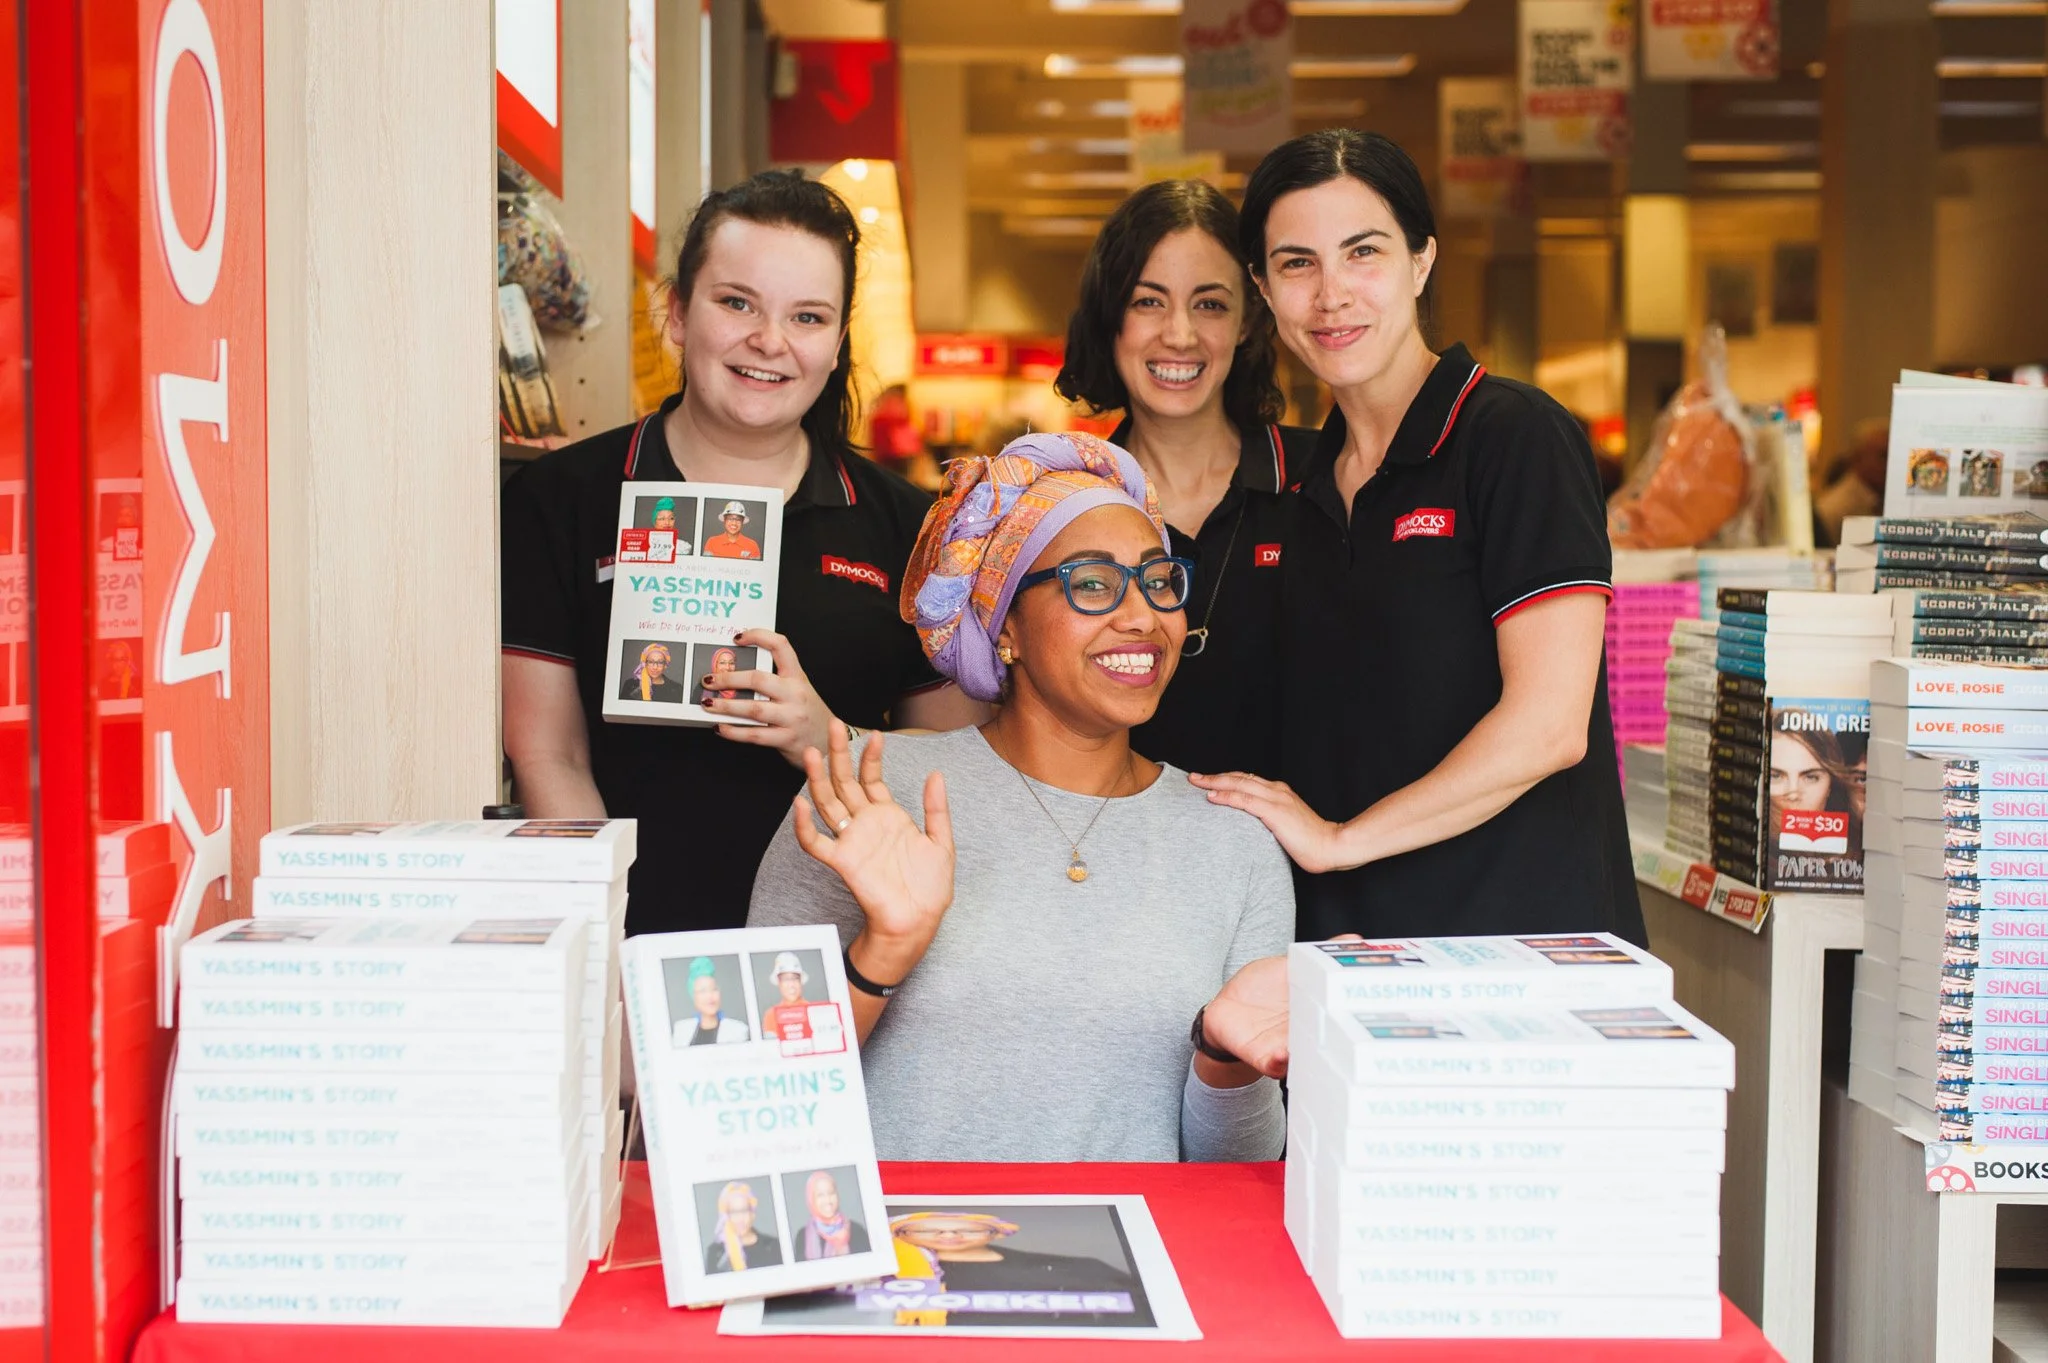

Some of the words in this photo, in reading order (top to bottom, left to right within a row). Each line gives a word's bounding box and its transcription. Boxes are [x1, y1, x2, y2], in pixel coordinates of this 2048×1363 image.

[1880, 525, 1933, 536] SCORCH
[1938, 527, 1985, 539] TRIALS
[1883, 550, 1936, 560] SCORCH
[1941, 552, 1986, 563] TRIALS
[629, 575, 764, 600] YASSMIN'S
[651, 596, 737, 618] STORY
[1920, 600, 1976, 610] SCORCH
[1981, 602, 2030, 612] TRIALS
[1919, 627, 1975, 637] SCORCH
[1979, 628, 2029, 639] TRIALS
[1916, 682, 1959, 694] LOVE,
[1781, 711, 1829, 731] JOHN
[1835, 713, 1871, 733] GRE
[1916, 722, 1959, 734] LOVE,
[1992, 772, 2048, 787] SINGL
[1992, 802, 2048, 817] SINGL
[1785, 815, 1796, 829] 2
[1814, 815, 1844, 832] $30
[1993, 832, 2048, 847] SINGL
[277, 851, 388, 868] YASSMIN'S
[398, 851, 465, 868] STORY
[1777, 854, 1828, 878] PAPER
[1990, 862, 2048, 877] SINGL
[270, 891, 380, 908] YASSMIN'S
[390, 891, 458, 908] STORY
[1994, 892, 2048, 907] SINGL
[1992, 922, 2048, 938] SINGL
[1991, 950, 2048, 967] SINGL
[202, 960, 321, 976] YASSMIN'S
[333, 960, 406, 976] STORY
[1344, 983, 1451, 998] YASSMIN'S
[1461, 983, 1527, 998] STORY
[202, 1001, 321, 1017] YASSMIN'S
[333, 1001, 406, 1017] STORY
[1985, 1009, 2048, 1025] SINGL
[202, 1044, 321, 1060] YASSMIN'S
[332, 1044, 405, 1060] STORY
[1985, 1037, 2048, 1053] SINGL
[1374, 1058, 1491, 1074] YASSMIN'S
[1502, 1058, 1574, 1074] STORY
[1985, 1066, 2048, 1082] SINGL
[194, 1087, 313, 1103] YASSMIN'S
[324, 1087, 398, 1103] STORY
[678, 1068, 846, 1107] YASSMIN'S
[1368, 1100, 1485, 1116] YASSMIN'S
[1495, 1100, 1567, 1116] STORY
[718, 1102, 818, 1135] STORY
[196, 1129, 314, 1146] YASSMIN'S
[326, 1129, 399, 1146] STORY
[1985, 1125, 2048, 1141] SINGL
[1365, 1143, 1482, 1158] YASSMIN'S
[1493, 1143, 1563, 1158] STORY
[199, 1171, 318, 1187] YASSMIN'S
[331, 1171, 402, 1187] STORY
[1361, 1185, 1477, 1200] YASSMIN'S
[1489, 1185, 1561, 1200] STORY
[202, 1213, 320, 1229] YASSMIN'S
[332, 1213, 405, 1229] STORY
[1357, 1227, 1475, 1243] YASSMIN'S
[1486, 1227, 1557, 1243] STORY
[205, 1254, 323, 1270] YASSMIN'S
[334, 1254, 406, 1270] STORY
[1358, 1269, 1475, 1285] YASSMIN'S
[1486, 1269, 1557, 1285] STORY
[200, 1295, 318, 1312] YASSMIN'S
[330, 1295, 401, 1312] STORY
[871, 1294, 1121, 1310] WORKER
[1363, 1310, 1479, 1326] YASSMIN'S
[1491, 1310, 1562, 1326] STORY
